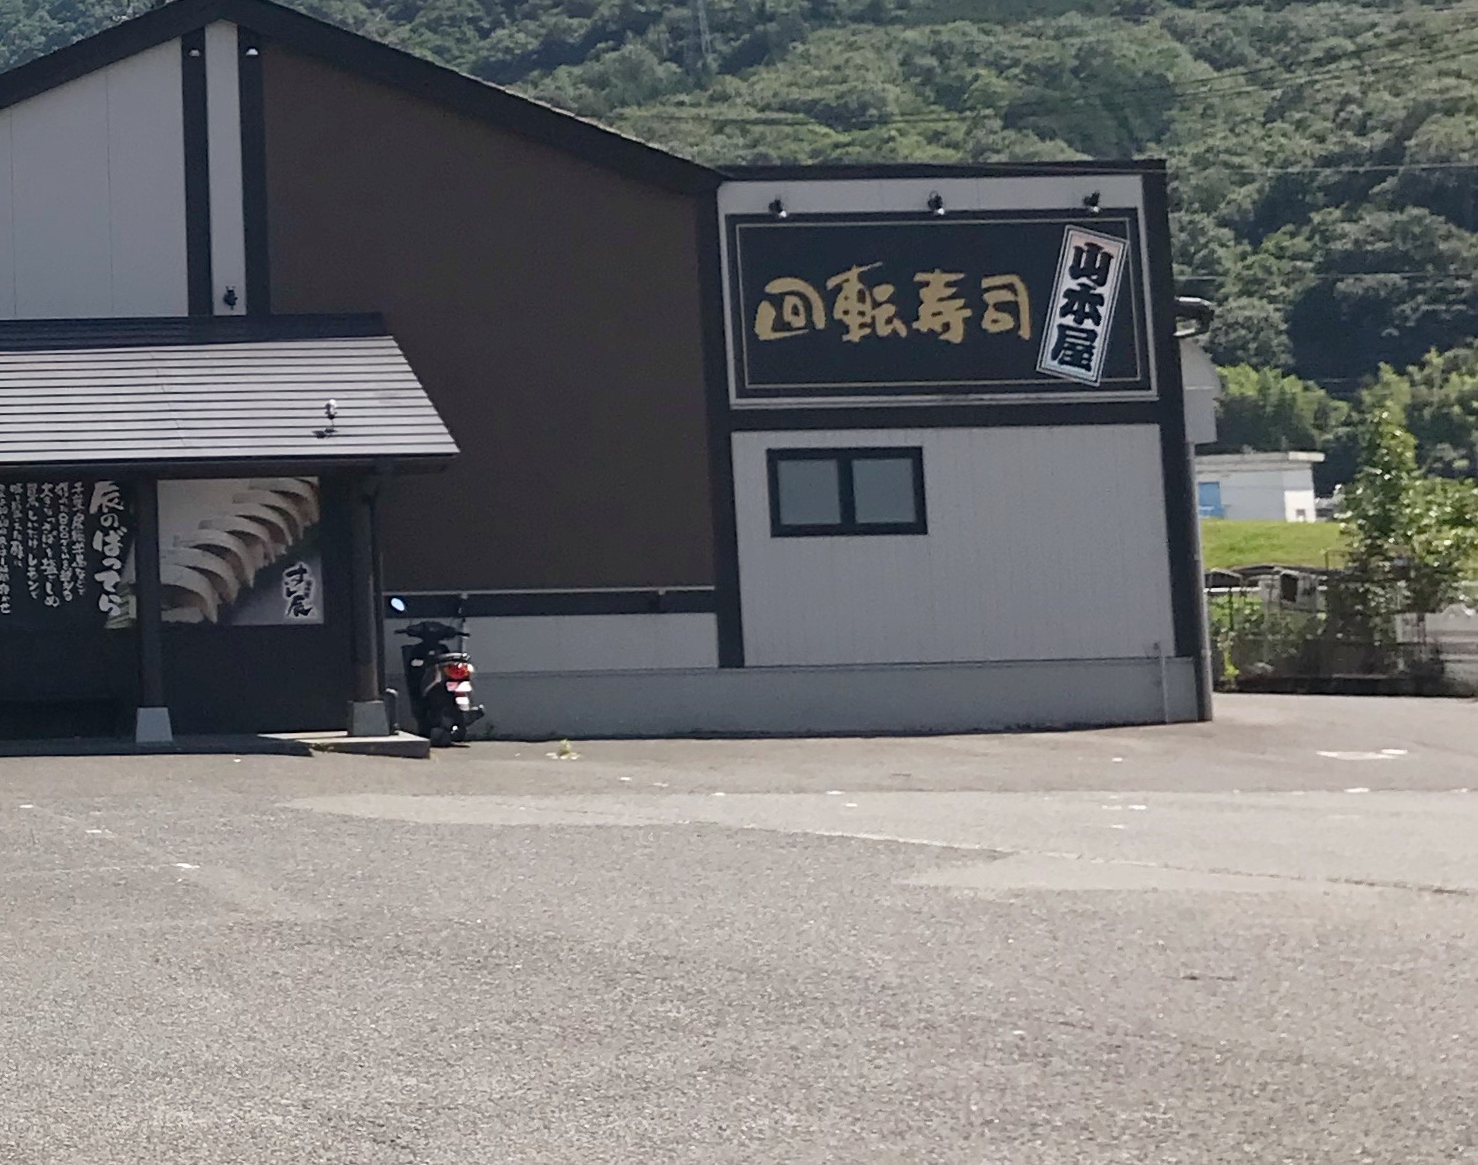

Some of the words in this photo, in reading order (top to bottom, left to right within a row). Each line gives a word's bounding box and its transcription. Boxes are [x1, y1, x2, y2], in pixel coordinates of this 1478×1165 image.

[753, 261, 1033, 345] 回転寿司
[1050, 241, 1115, 374] 山本屋
